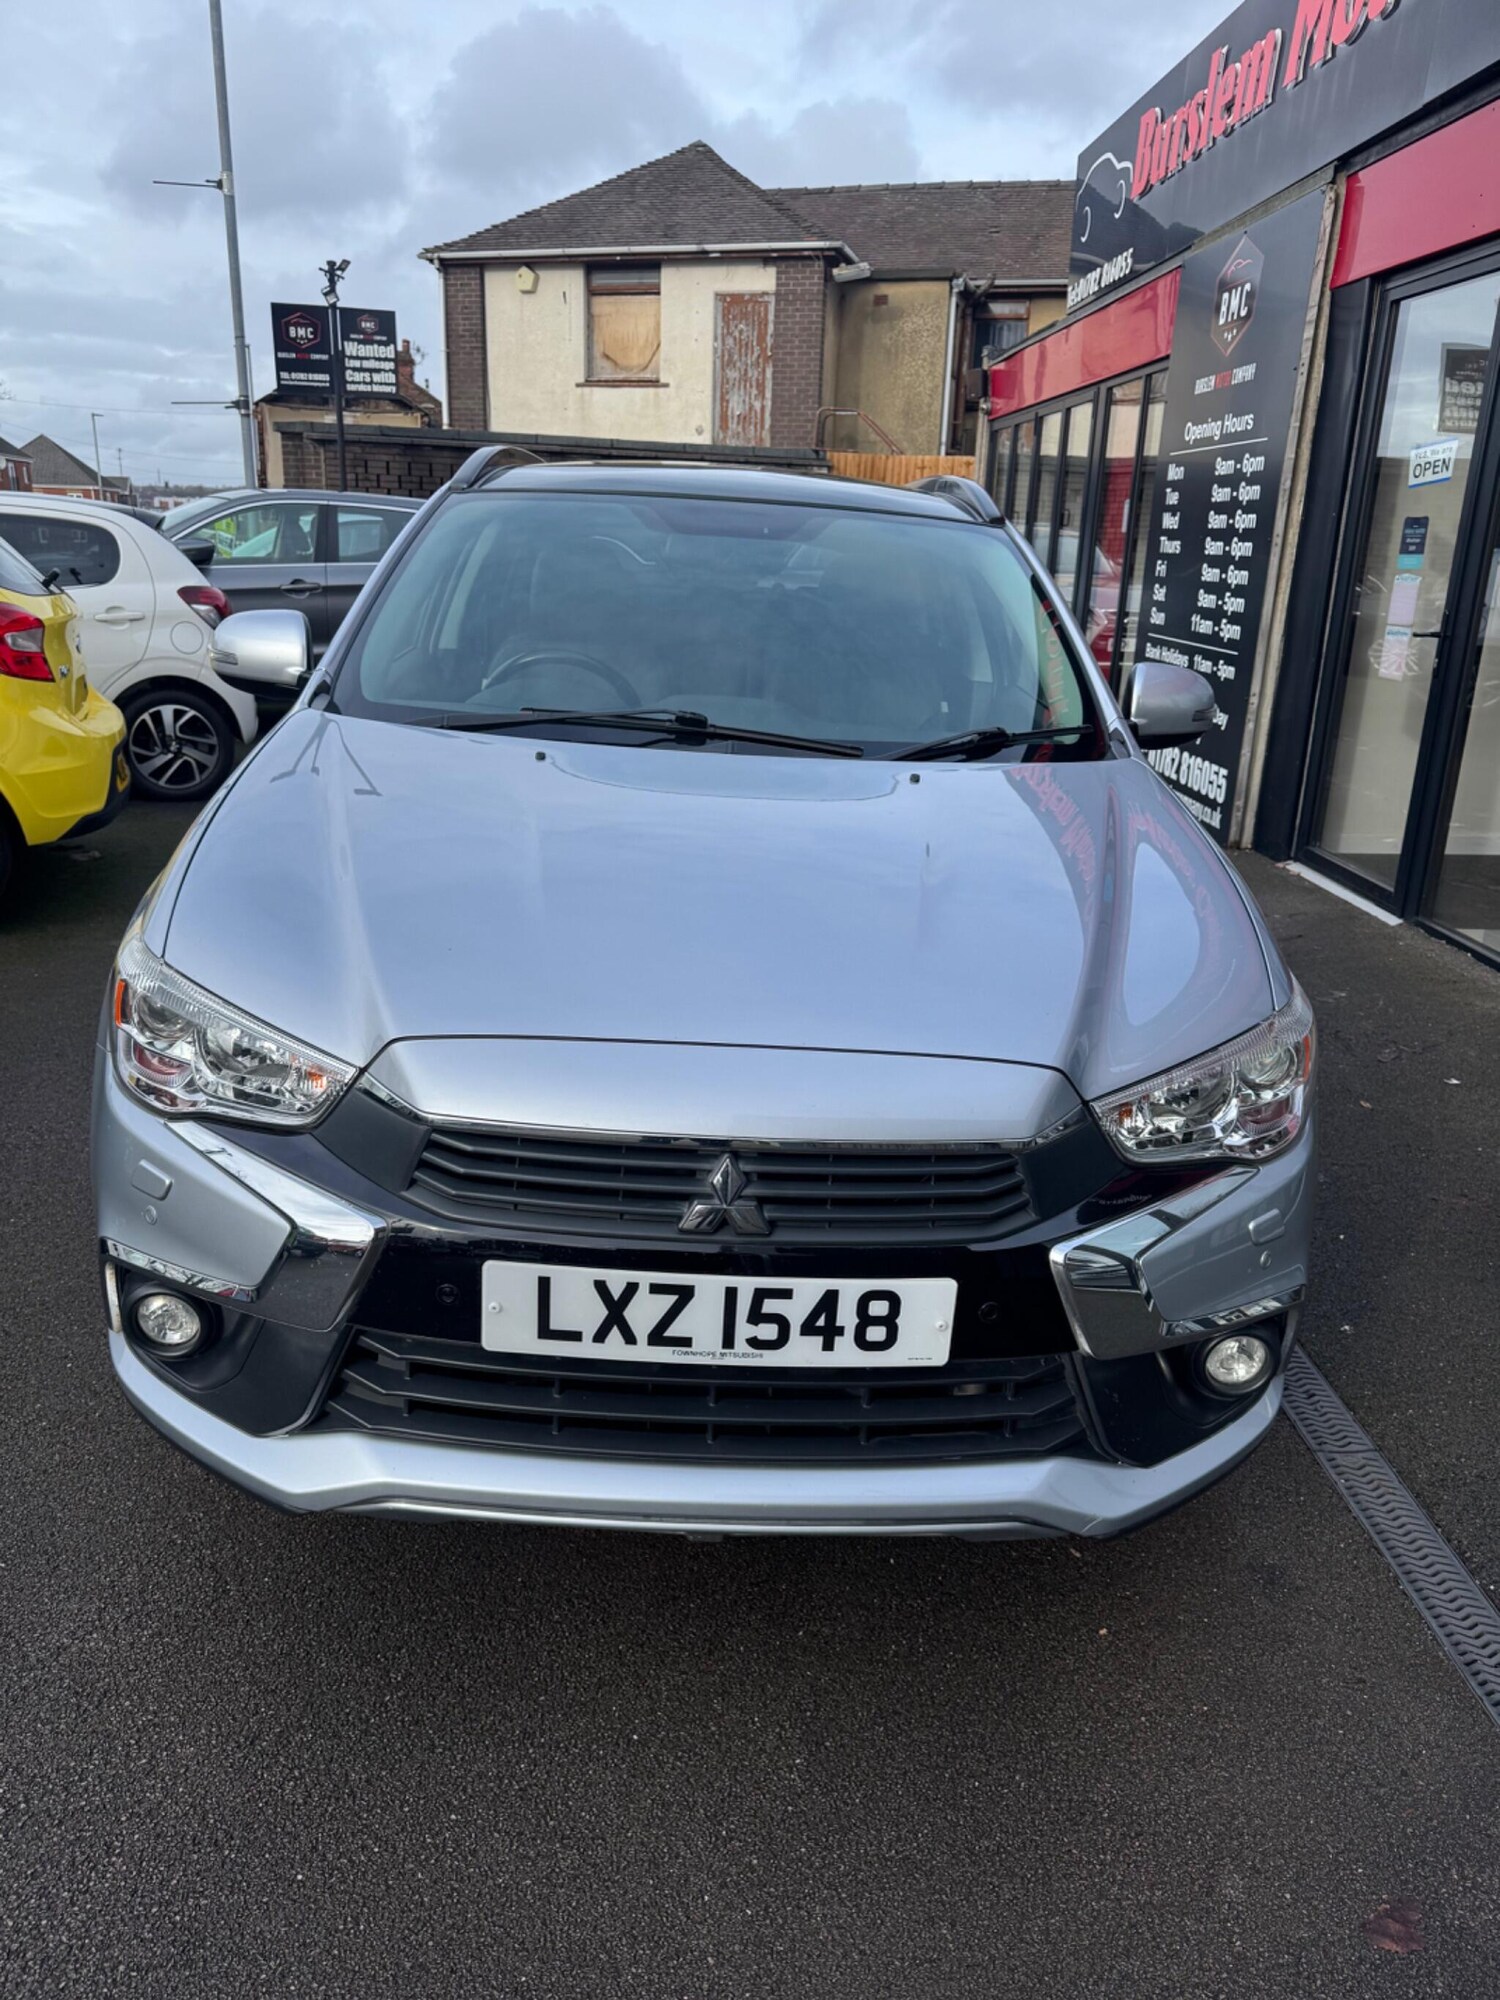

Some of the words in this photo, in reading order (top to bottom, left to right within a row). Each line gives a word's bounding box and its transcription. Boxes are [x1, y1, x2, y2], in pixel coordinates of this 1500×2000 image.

[1130, 28, 1281, 201] Burslem
[1218, 282, 1251, 326] BMC
[289, 326, 314, 339] BMC
[361, 321, 375, 329] BMC
[344, 341, 395, 358] Wanted
[345, 357, 361, 368] Low
[362, 359, 395, 370] mileage
[345, 369, 371, 383] Cars
[371, 371, 396, 384] with
[372, 384, 396, 394] history
[1184, 417, 1222, 445] Opening
[1223, 412, 1255, 434] Hours
[1167, 463, 1184, 481] Mon
[1215, 456, 1235, 476] 9am
[1242, 453, 1265, 477] 6pm
[1412, 457, 1452, 479] OPEN
[1165, 488, 1180, 505] Tue
[1211, 484, 1231, 503] 9am
[1238, 481, 1261, 505] 6pm
[1162, 512, 1180, 530] Wed
[1207, 510, 1227, 529] 9am
[1234, 509, 1257, 533] 6pm
[1159, 536, 1181, 554] Thurs
[1204, 537, 1224, 556] 9am
[1230, 537, 1253, 561] 6pm
[1155, 560, 1167, 578] Fri
[1201, 563, 1221, 582] 9am
[1226, 564, 1249, 588] 6pm
[1153, 584, 1166, 602] Sat
[1197, 589, 1216, 609] 9am
[1223, 591, 1245, 615] 5pm
[1150, 607, 1166, 626] Sun
[1190, 614, 1213, 635] 11am
[1220, 616, 1241, 641] 5pm
[1145, 642, 1160, 660] Bank
[1160, 646, 1189, 668] Holidays
[1193, 654, 1213, 674] 11am
[1217, 660, 1235, 681] 5pm
[1179, 751, 1228, 804] 816055
[536, 1275, 697, 1347] LXZ
[720, 1285, 902, 1352] 1548
